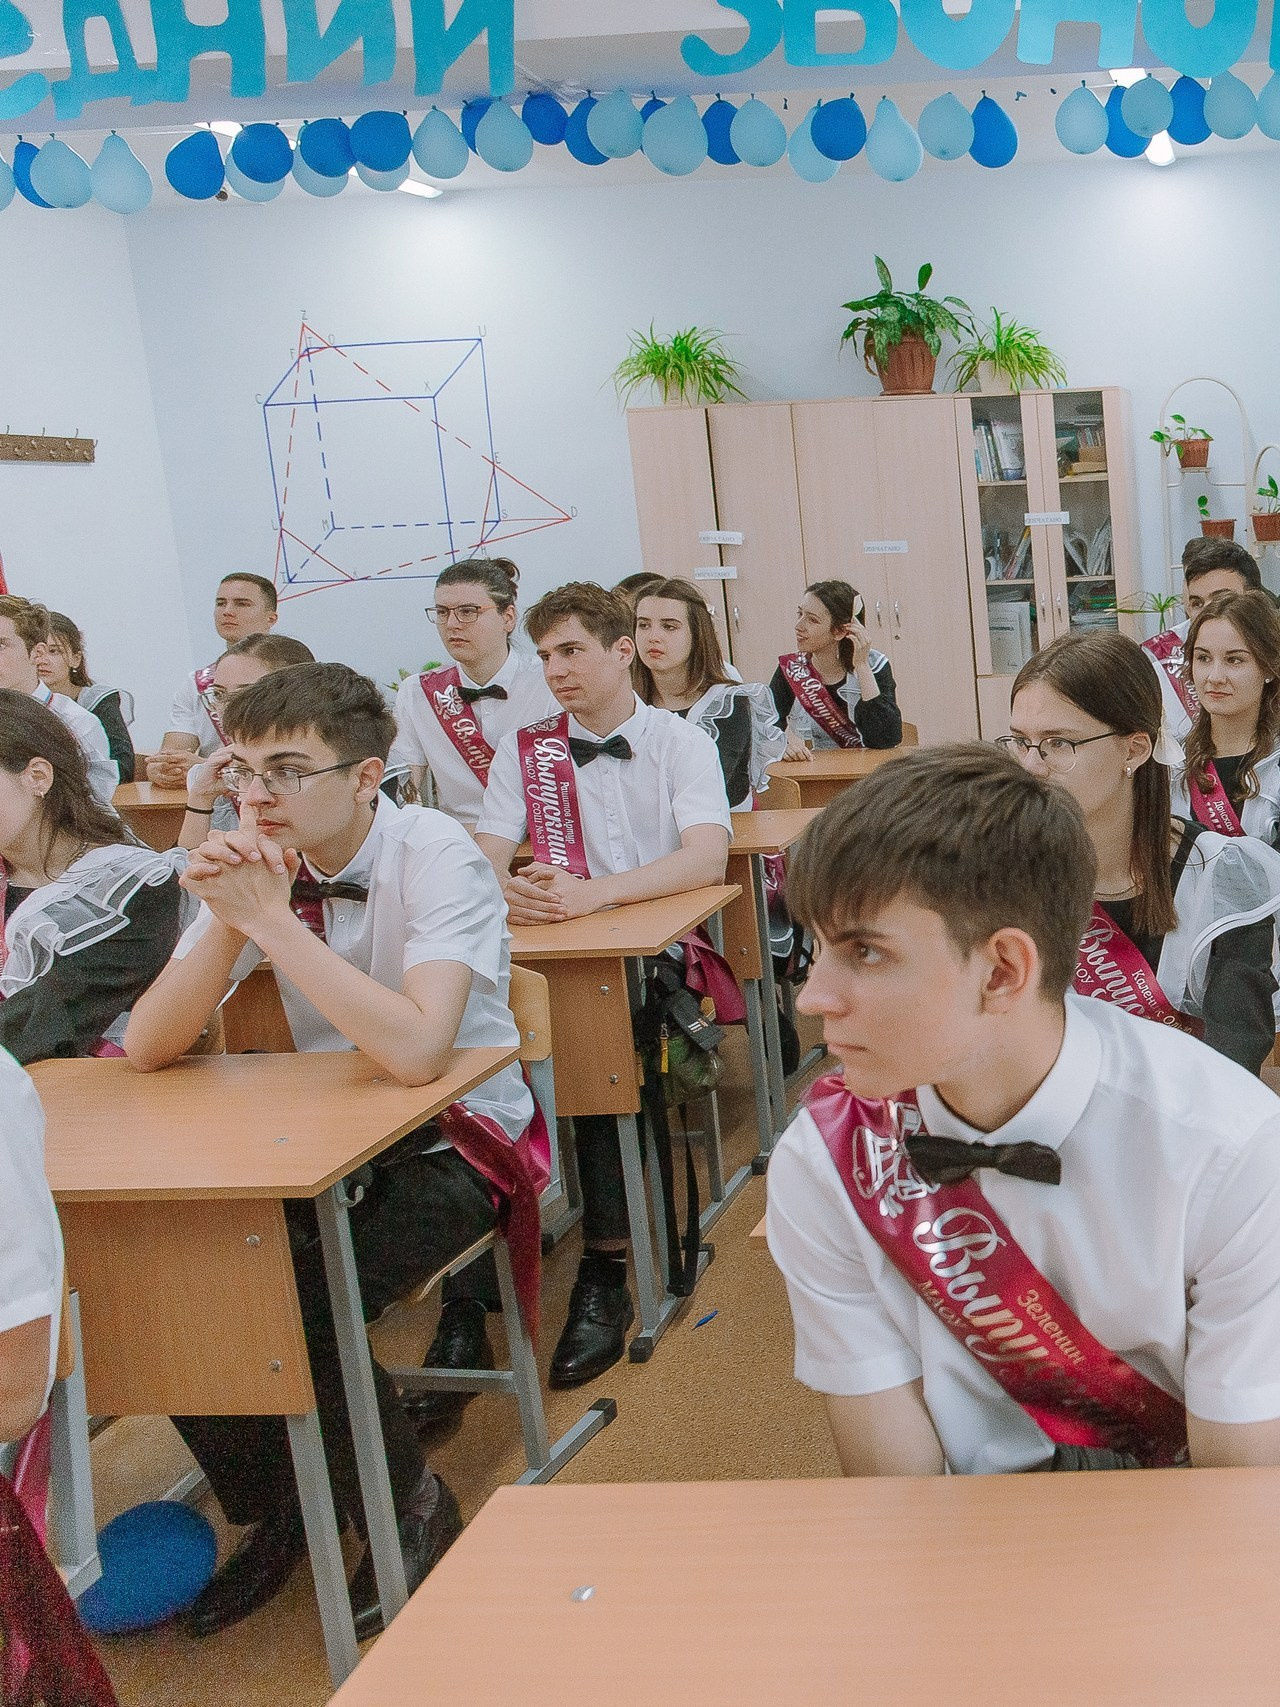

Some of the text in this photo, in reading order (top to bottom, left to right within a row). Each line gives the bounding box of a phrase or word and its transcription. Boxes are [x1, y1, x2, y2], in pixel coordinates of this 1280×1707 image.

[478, 324, 487, 337] U
[524, 755, 537, 781] МАОУ
[532, 801, 543, 824] СОШ
[526, 737, 571, 867] Выпускник
[1016, 1289, 1087, 1365] Зеленин
